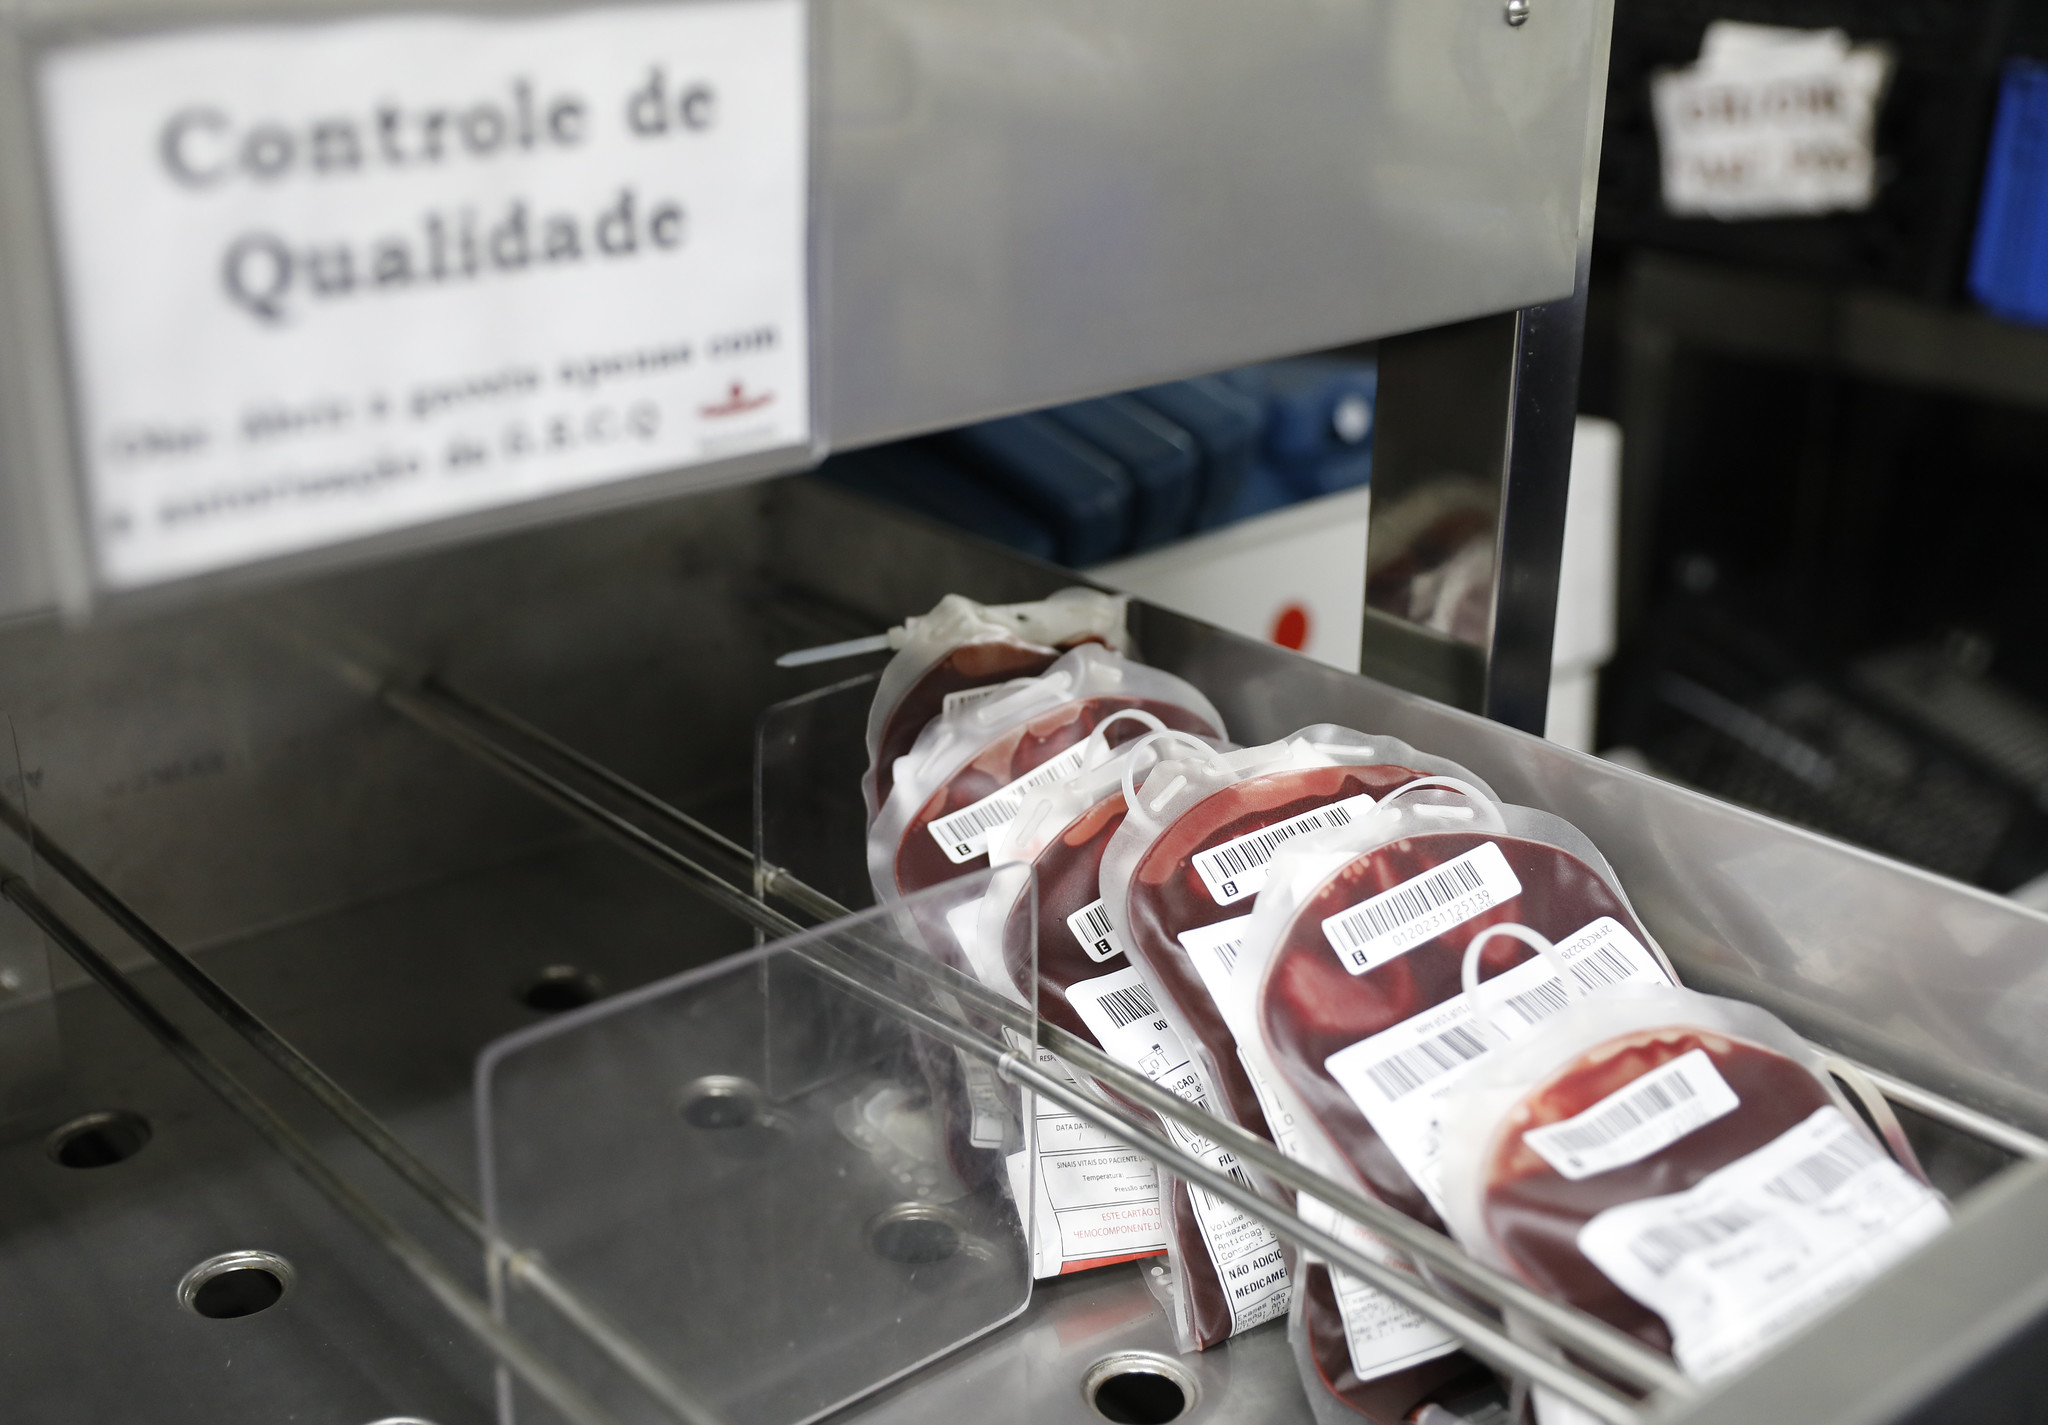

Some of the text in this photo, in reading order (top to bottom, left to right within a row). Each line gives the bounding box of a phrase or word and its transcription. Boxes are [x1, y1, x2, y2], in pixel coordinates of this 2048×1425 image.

[156, 64, 720, 192] Controle de
[217, 188, 690, 328] Qualidade
[1392, 889, 1490, 947] 0120231125139
[1057, 1160, 1076, 1169] SINAIS
[1078, 1159, 1097, 1167] VITAIS
[1108, 1155, 1138, 1164] PACIENTE
[1101, 1212, 1121, 1221] ESTE
[1121, 1208, 1153, 1220] CARTÃO
[1210, 1213, 1244, 1232] Volume
[1228, 1263, 1250, 1280] NÃO
